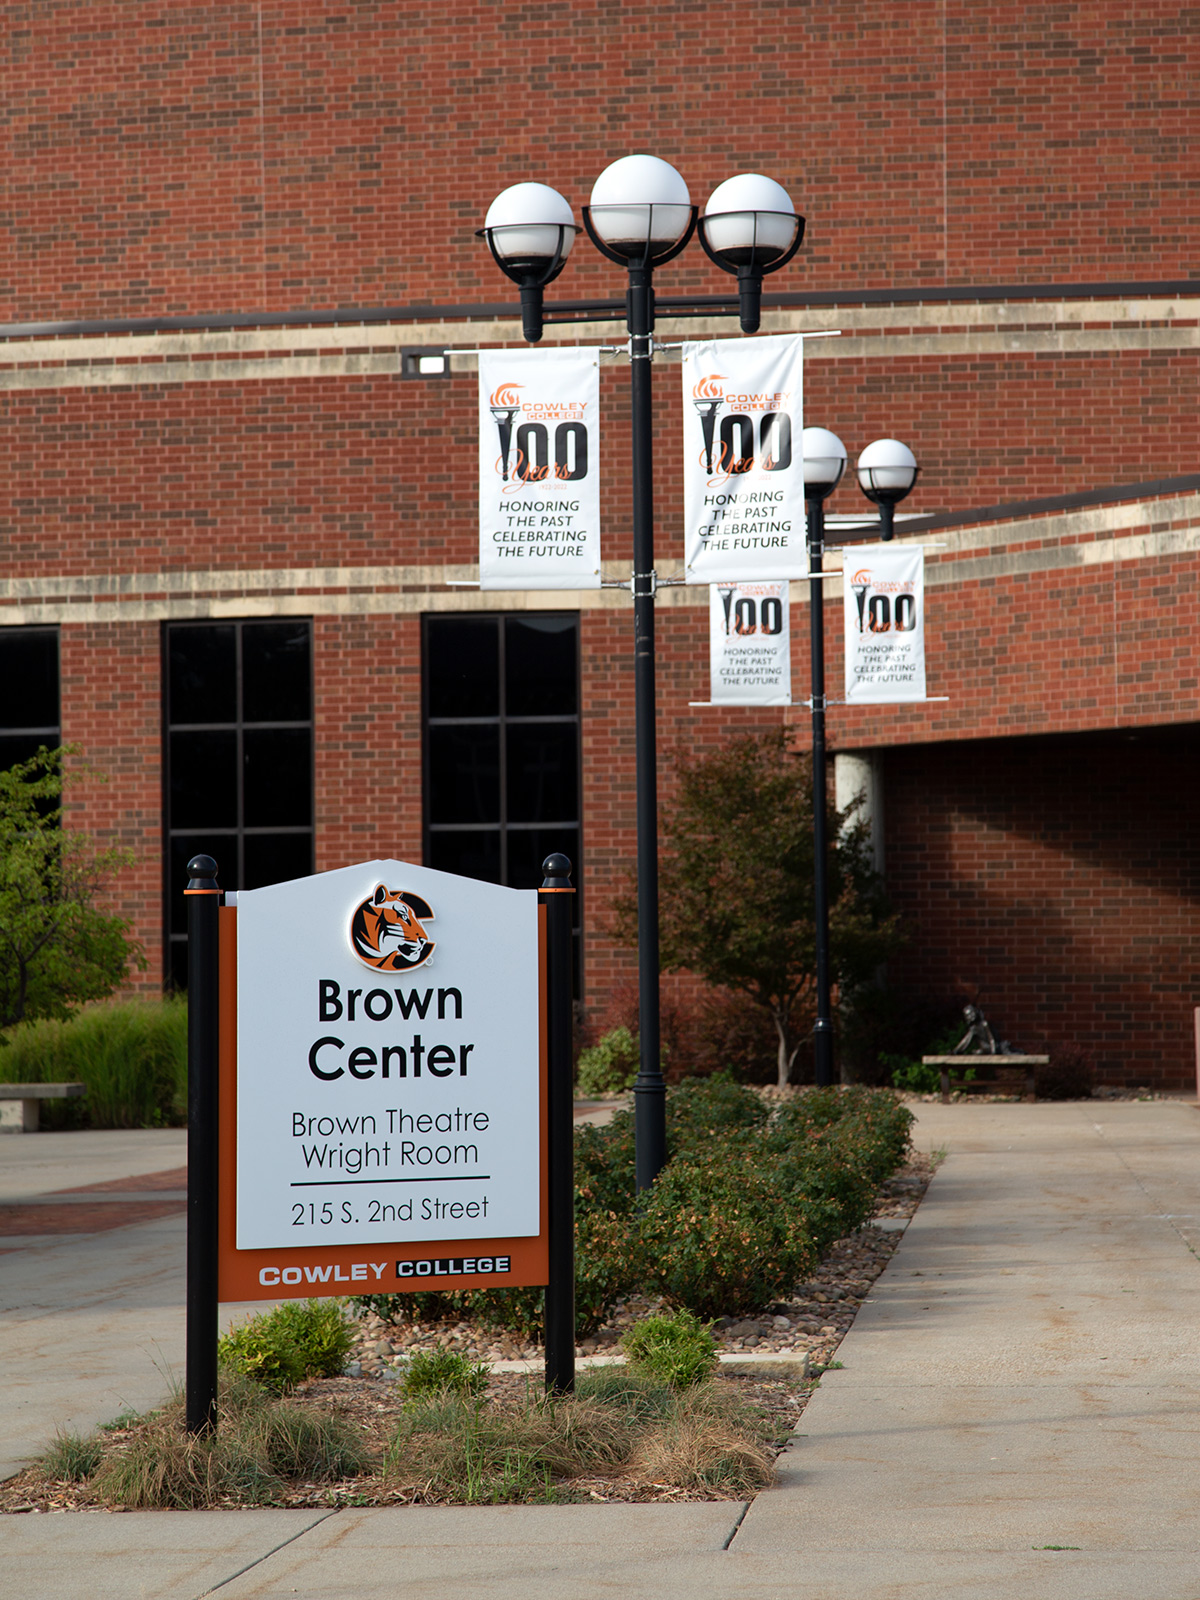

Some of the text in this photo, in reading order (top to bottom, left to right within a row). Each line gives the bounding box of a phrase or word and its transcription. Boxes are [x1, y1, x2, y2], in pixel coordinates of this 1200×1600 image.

[725, 392, 791, 403] COWLEY
[522, 402, 588, 412] COWLEY
[527, 411, 584, 421] COLLEGE
[495, 448, 573, 495] Years
[704, 490, 784, 506] HONORING
[499, 500, 580, 512] HONORING
[712, 506, 778, 520] THE PAST
[507, 515, 573, 527] THE PAST
[698, 520, 792, 537] CELEBRATING
[492, 530, 587, 543] CELEBRATING
[702, 536, 789, 551] THE FUTURE
[497, 545, 584, 557] THE FUTURE
[724, 647, 778, 656] HONORING
[858, 644, 911, 653] HONORING
[751, 657, 773, 665] PAST
[864, 654, 881, 663] THE
[720, 667, 782, 676] CELEBRATING
[854, 664, 916, 673] CELEBRATING
[723, 677, 780, 685] THE FUTURE
[319, 979, 463, 1022] Brown
[308, 1034, 475, 1081] Center
[292, 1107, 489, 1137] Brown Theatre
[302, 1141, 478, 1174] Wright Room
[291, 1196, 489, 1226] 215 S. 2nd Street
[258, 1257, 509, 1286] COWLEY COLLEGE
